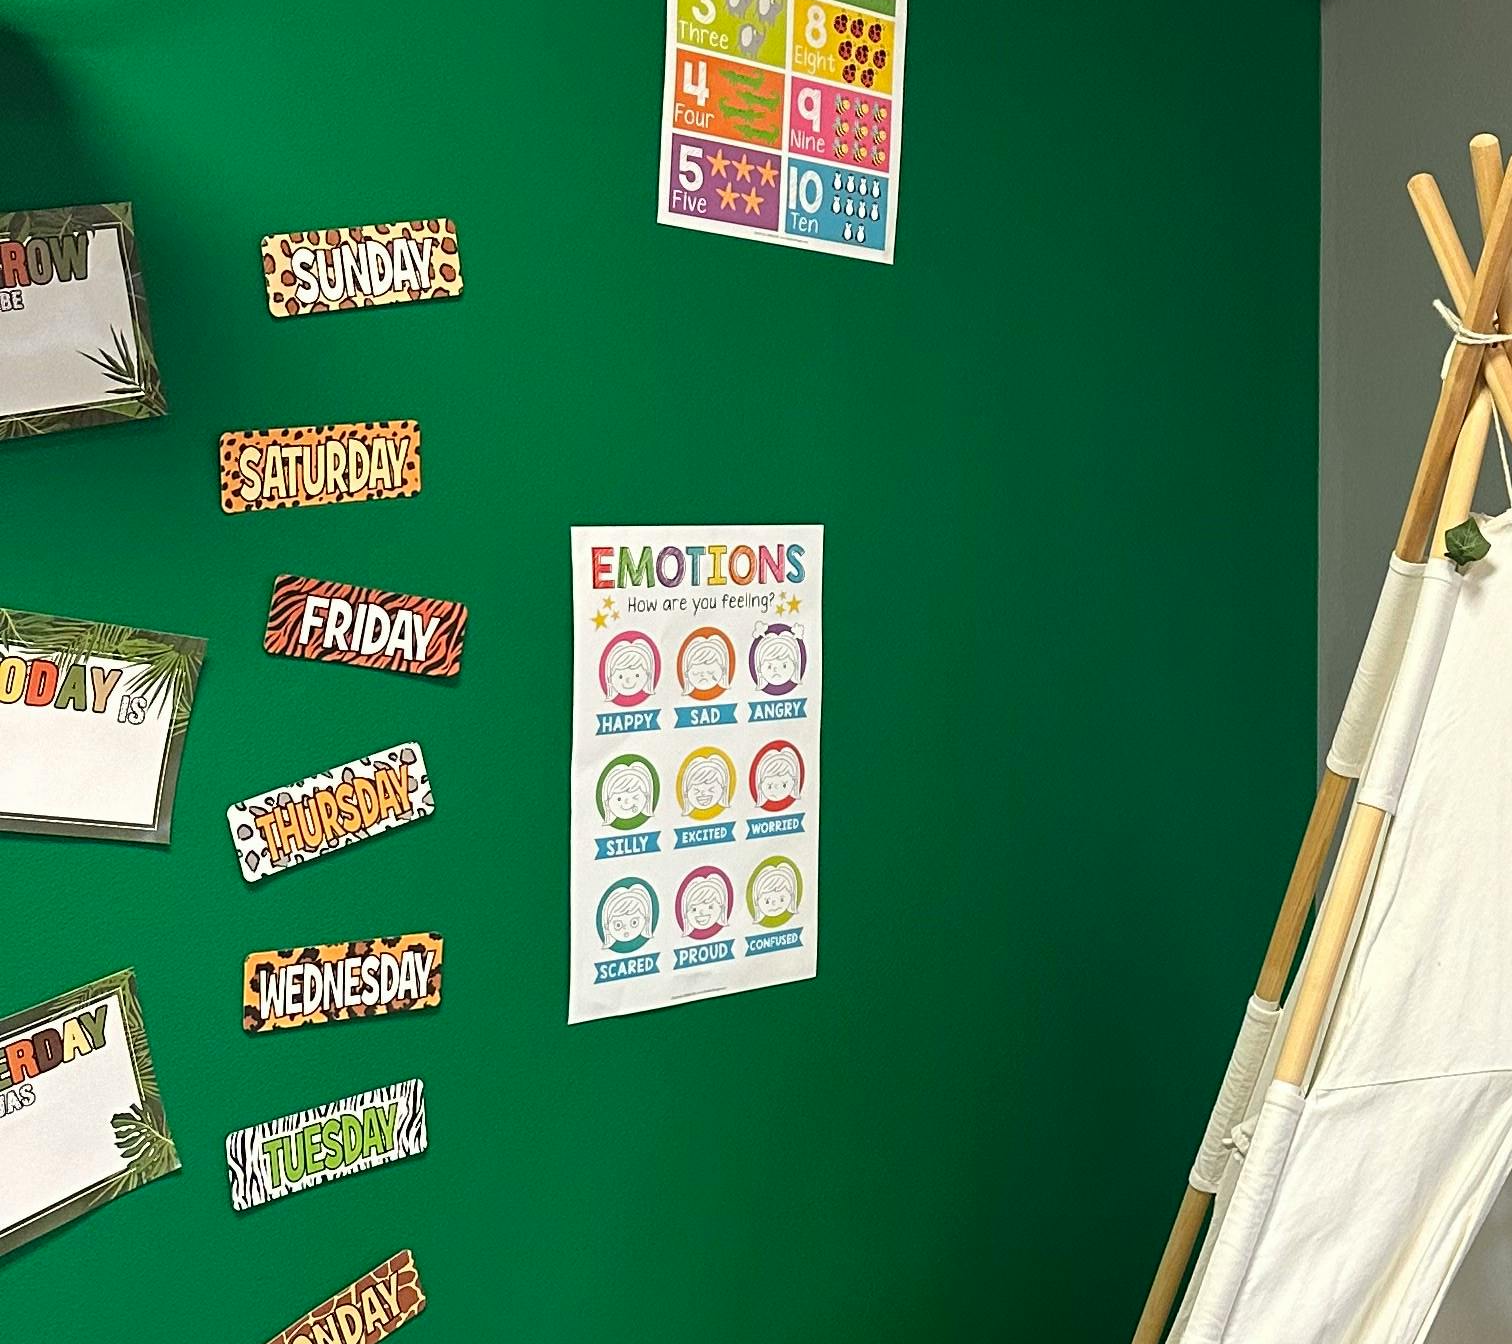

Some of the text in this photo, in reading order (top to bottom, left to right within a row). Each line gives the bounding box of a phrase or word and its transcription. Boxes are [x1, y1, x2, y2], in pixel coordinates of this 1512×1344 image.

[679, 19, 728, 49] Three
[805, 4, 827, 48] 8
[683, 60, 710, 107] 4
[674, 104, 714, 128] Four
[797, 87, 822, 132] 9
[679, 144, 704, 191] 5
[788, 166, 823, 213] 10
[791, 212, 819, 234] Ten
[0, 233, 90, 288] ROW
[290, 238, 434, 304] SUNDAY
[239, 437, 410, 501] SATURDAY
[592, 544, 806, 589] EMOTIONS
[628, 592, 776, 615] How are you feeling?
[299, 594, 441, 662] FRIDAY
[0, 656, 147, 725] ODAY IS
[754, 702, 802, 719] ANGRY
[602, 713, 654, 733] HAPPY
[691, 710, 721, 724] SAD
[255, 764, 413, 866] THURSDAY
[682, 827, 727, 843] EXCITED
[751, 818, 799, 834] WORRIED
[606, 836, 648, 856] SILLY
[679, 944, 729, 965] PROUD
[750, 933, 798, 951] CONFUSED
[259, 949, 436, 1019] WEDNESDAY
[600, 957, 654, 979] SCARED
[263, 1103, 398, 1188] TUESDAY
